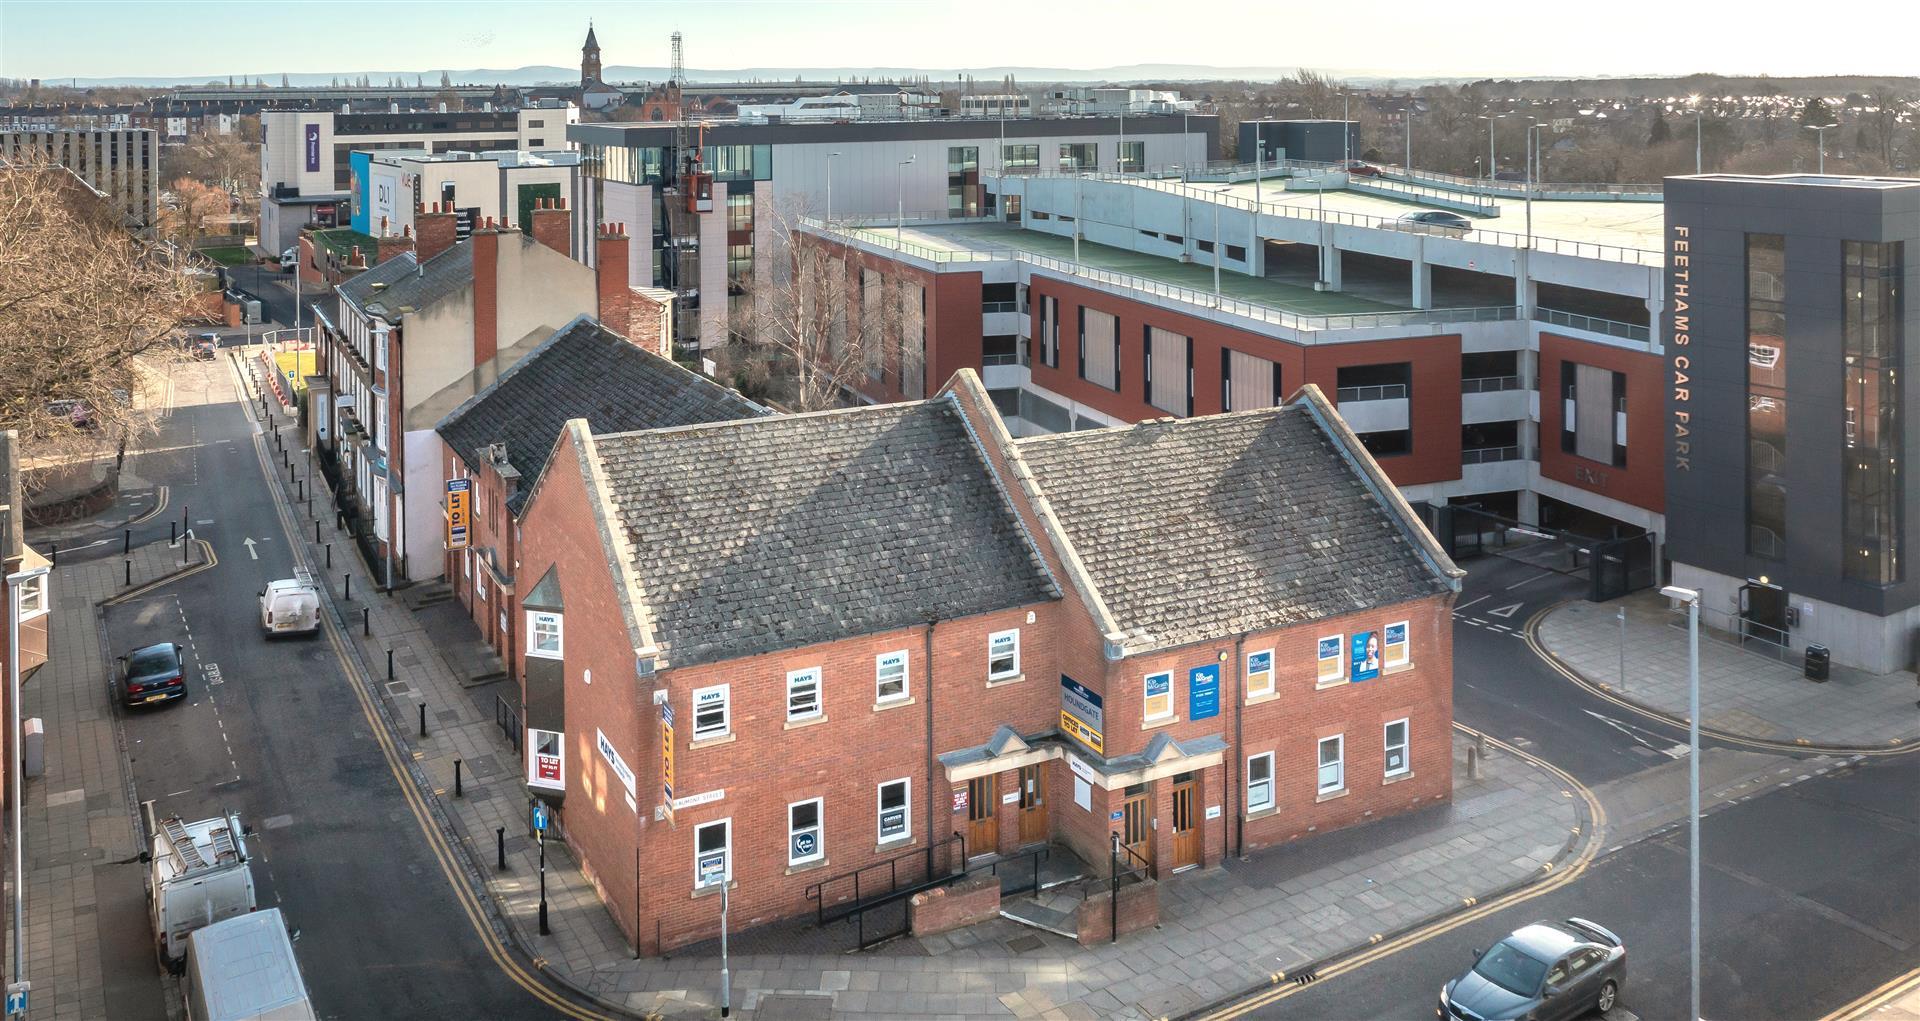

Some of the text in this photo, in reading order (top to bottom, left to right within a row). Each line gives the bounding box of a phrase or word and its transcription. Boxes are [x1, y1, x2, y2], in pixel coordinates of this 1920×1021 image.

[1674, 226, 1691, 472] FEETHAMS CAR PARK
[1576, 464, 1609, 489] EXIT
[452, 493, 461, 509] LET
[452, 512, 461, 526] TO
[994, 636, 1011, 644] HAYS
[882, 658, 900, 666] HAYS
[794, 674, 813, 684] HAYS
[701, 692, 721, 701] HAYS
[1064, 693, 1100, 721] HOUNDGATE
[1063, 721, 1071, 729] TO
[1070, 725, 1079, 735] LET
[600, 736, 616, 765] HAYS
[665, 757, 670, 778] TO
[703, 791, 723, 801] STREET
